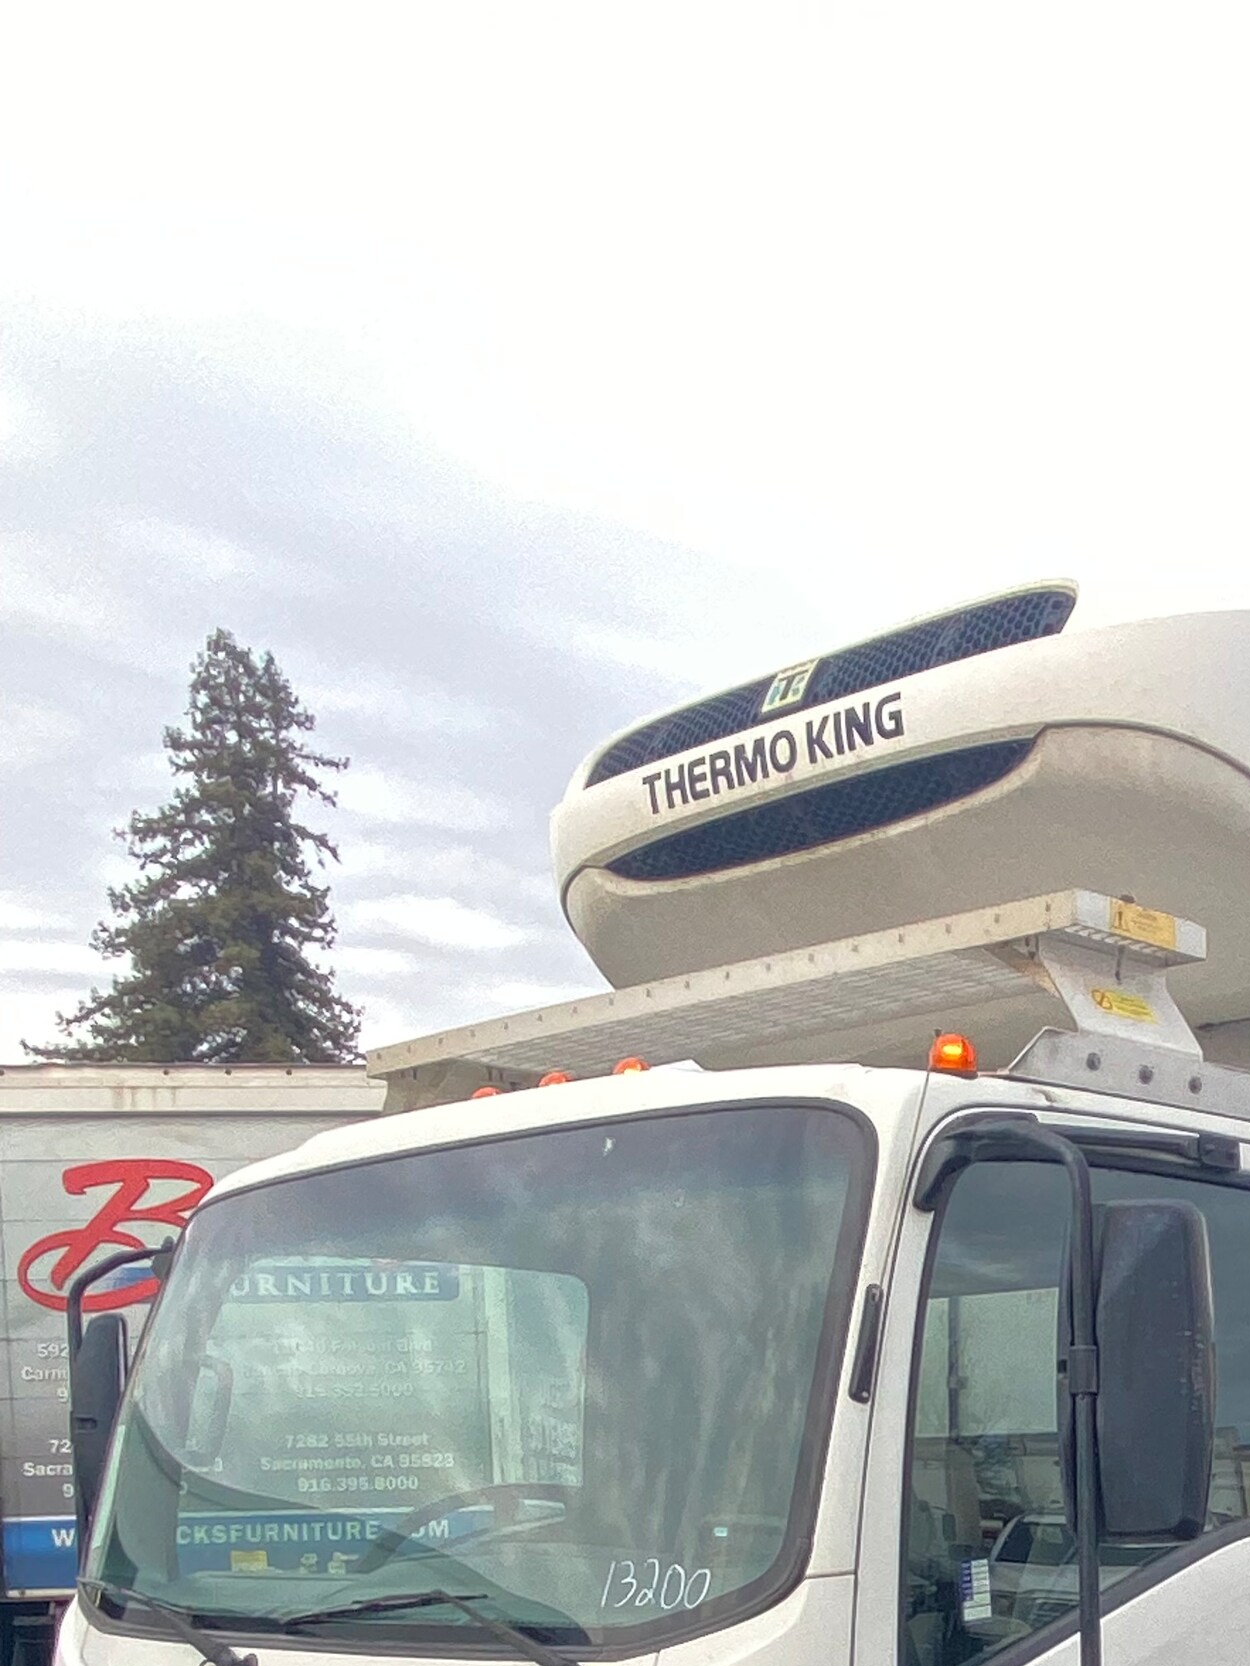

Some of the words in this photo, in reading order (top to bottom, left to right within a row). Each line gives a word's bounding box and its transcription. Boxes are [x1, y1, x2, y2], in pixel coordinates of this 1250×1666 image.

[642, 730, 798, 815] THERMO
[805, 692, 905, 764] KING
[229, 1271, 440, 1297] URNITURE
[37, 1343, 70, 1358] 592
[21, 1367, 69, 1381] Carm
[49, 1440, 72, 1453] 72
[377, 1433, 429, 1448] Street
[371, 1454, 395, 1469] CA
[23, 1462, 73, 1477] Sacra
[176, 1520, 380, 1544] CKSFURNITURE
[601, 1558, 711, 1609] 13200
